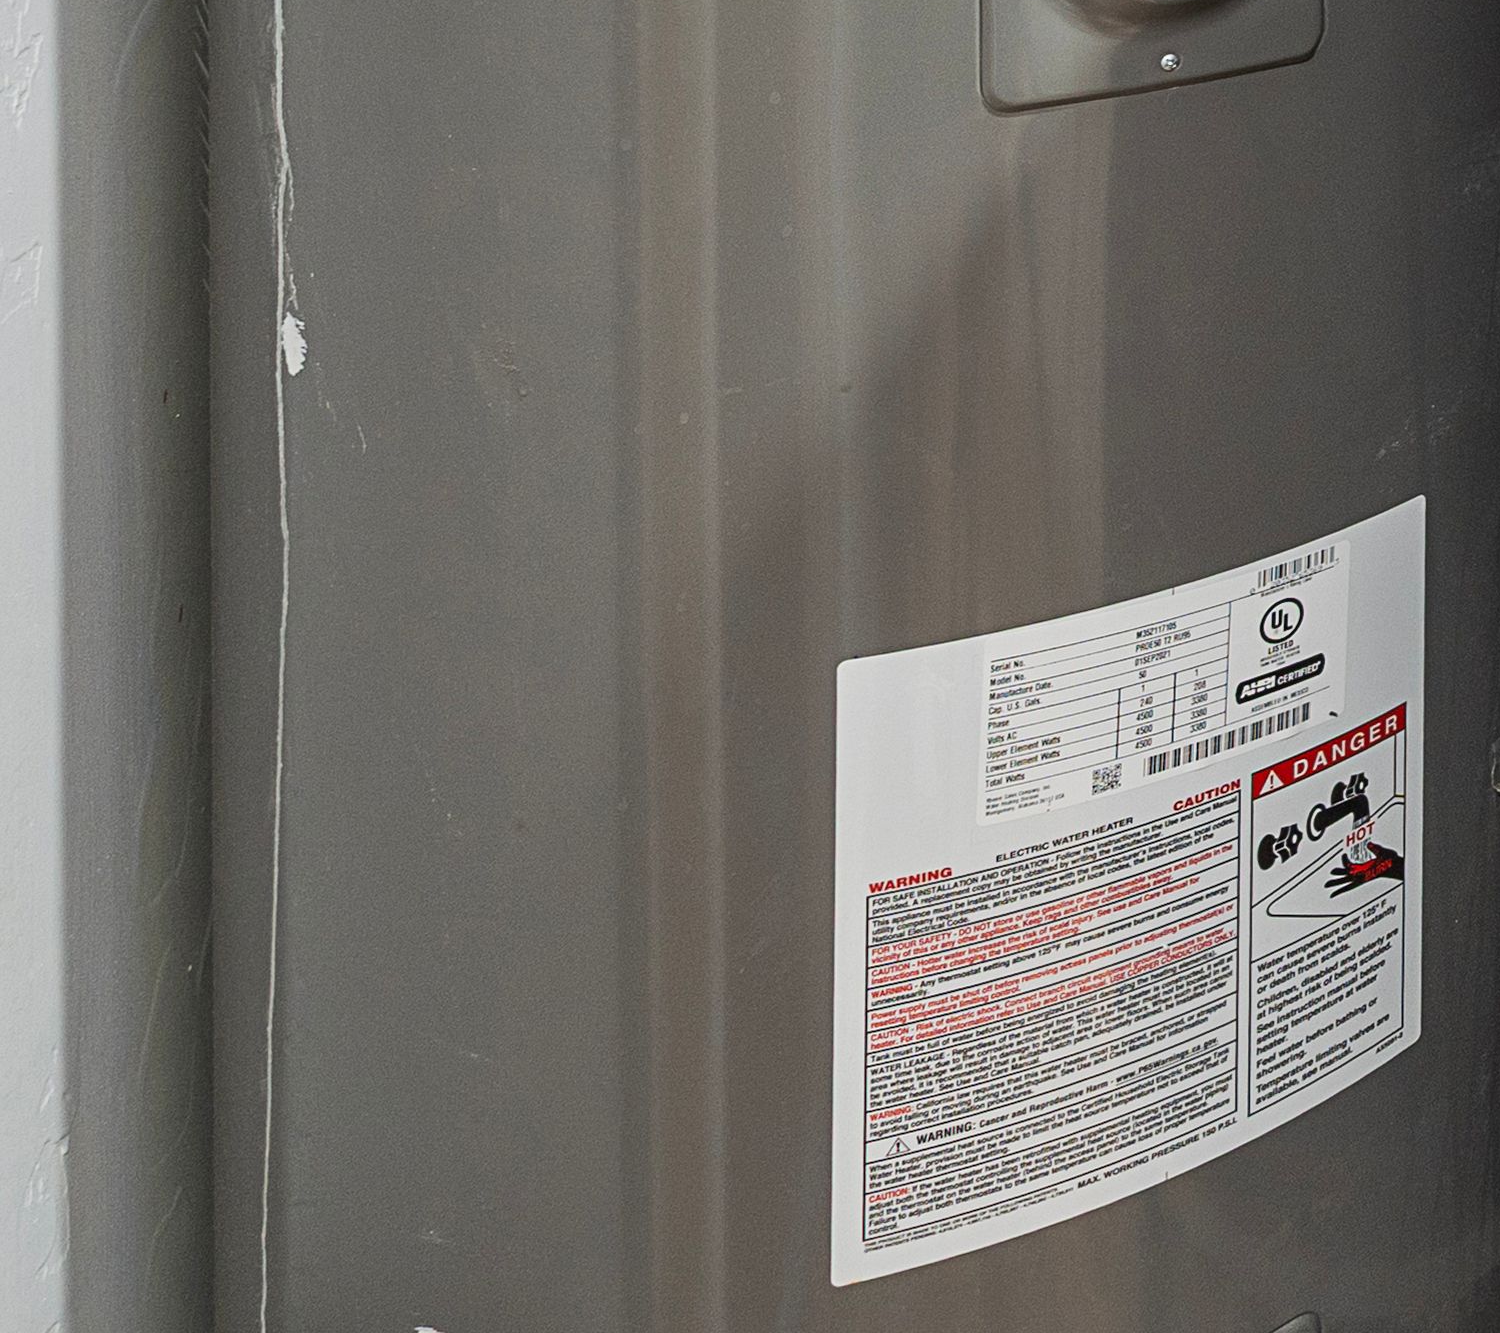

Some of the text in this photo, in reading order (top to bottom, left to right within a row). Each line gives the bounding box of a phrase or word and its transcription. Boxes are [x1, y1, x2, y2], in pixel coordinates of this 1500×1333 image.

[1271, 609, 1293, 631] UL
[990, 674, 1012, 687] Model
[1014, 672, 1026, 682] No.
[1164, 636, 1172, 646] T2
[990, 660, 1012, 673] Serial
[1014, 659, 1026, 668] No.
[1268, 639, 1294, 655] LISTED
[987, 693, 1208, 761] Upper Element Watts 4500 3380
[1293, 714, 1398, 779] DANGER
[985, 721, 1207, 789] Total Watts 4500 3380
[1173, 779, 1241, 811] CAUTION
[995, 817, 1134, 863] ELECTRIC WATER HEATER
[1346, 821, 1375, 847] HOT
[868, 867, 952, 894] WARNING
[1257, 955, 1284, 973] Water
[1286, 927, 1340, 959] temperature
[1341, 917, 1361, 932] over
[1381, 899, 1387, 908] F
[1077, 1175, 1101, 1189] MAX.
[1103, 1156, 1149, 1179] WORKING
[1151, 1134, 1200, 1160] PRESSURE
[1202, 1127, 1217, 1139] 150
